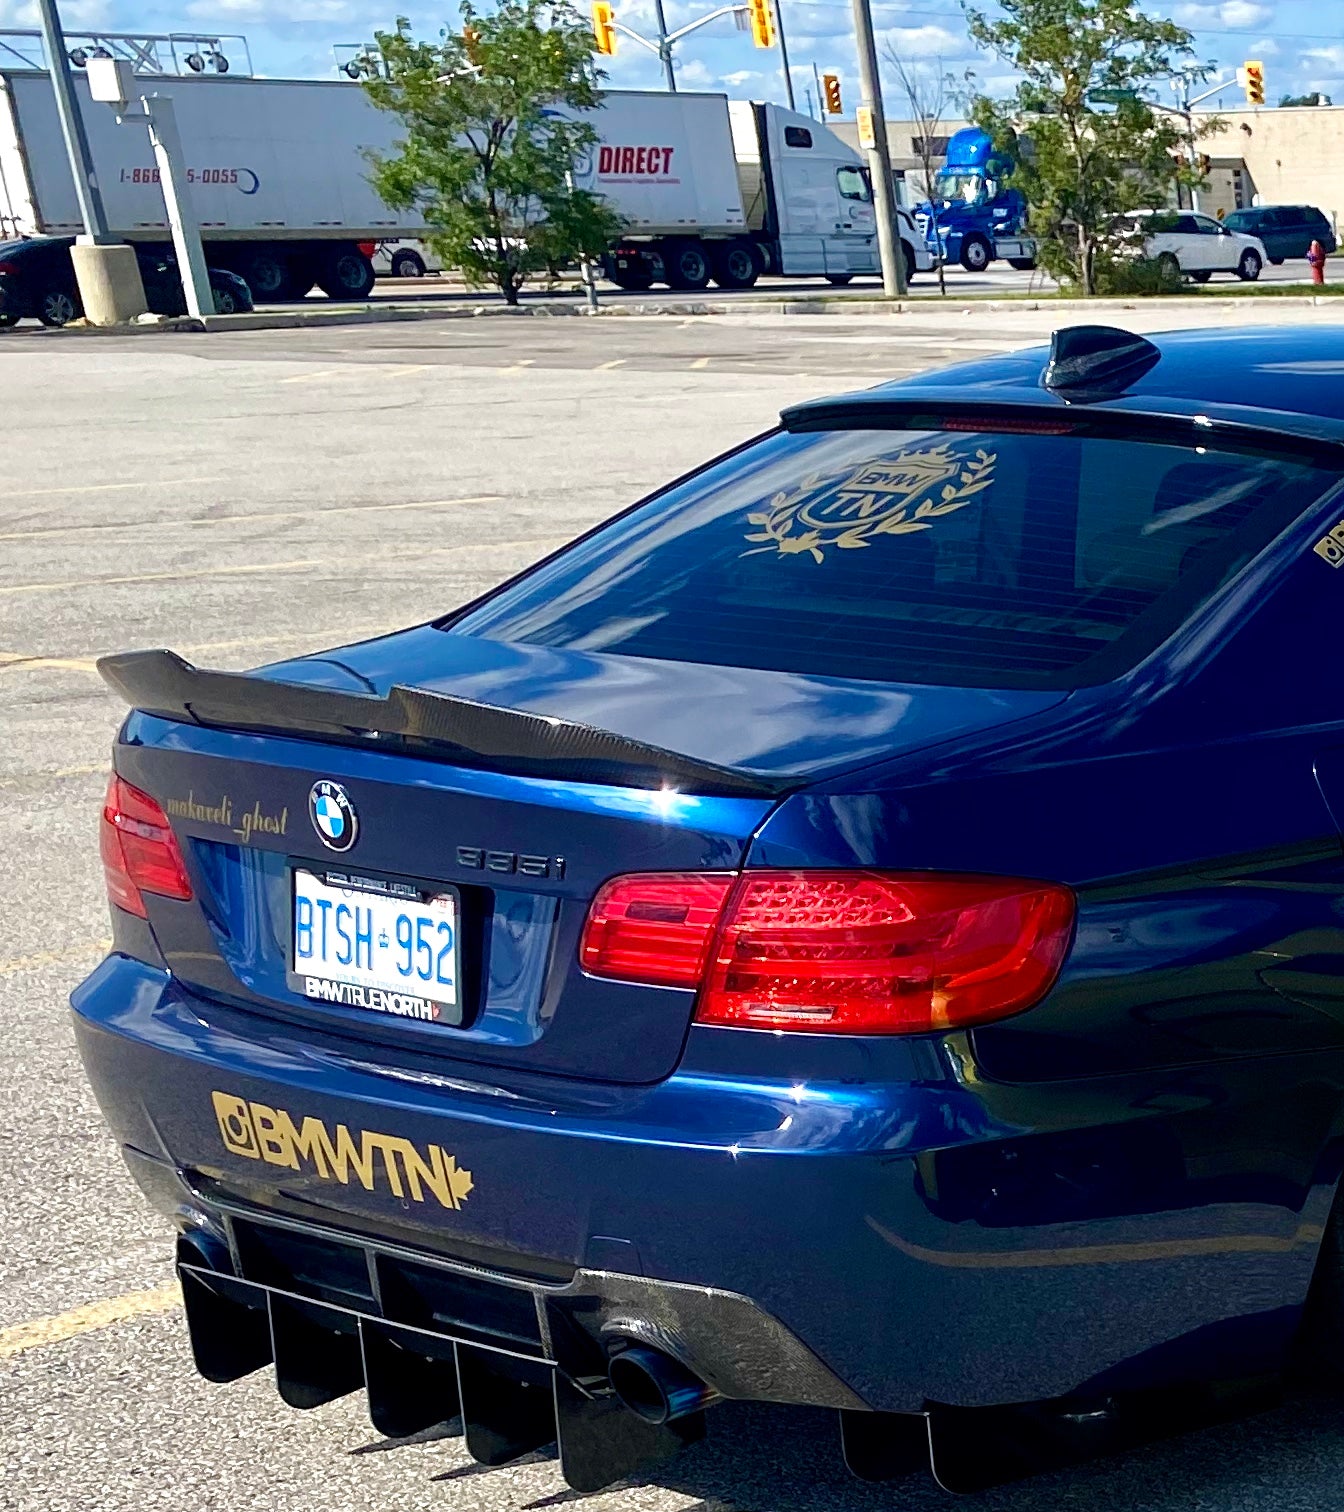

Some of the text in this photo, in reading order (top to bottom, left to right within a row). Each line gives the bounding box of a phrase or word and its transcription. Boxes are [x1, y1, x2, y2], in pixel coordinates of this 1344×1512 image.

[598, 146, 674, 175] DIRECT
[856, 471, 929, 488] BMW
[820, 492, 895, 518] TN
[311, 783, 349, 808] BMW
[167, 789, 288, 844] makaveli_ghost
[456, 845, 566, 880] 335i
[296, 895, 454, 986] BTSH 952
[305, 976, 433, 1021] BMWTRUENORTH
[248, 1101, 455, 1210] BMWTN
